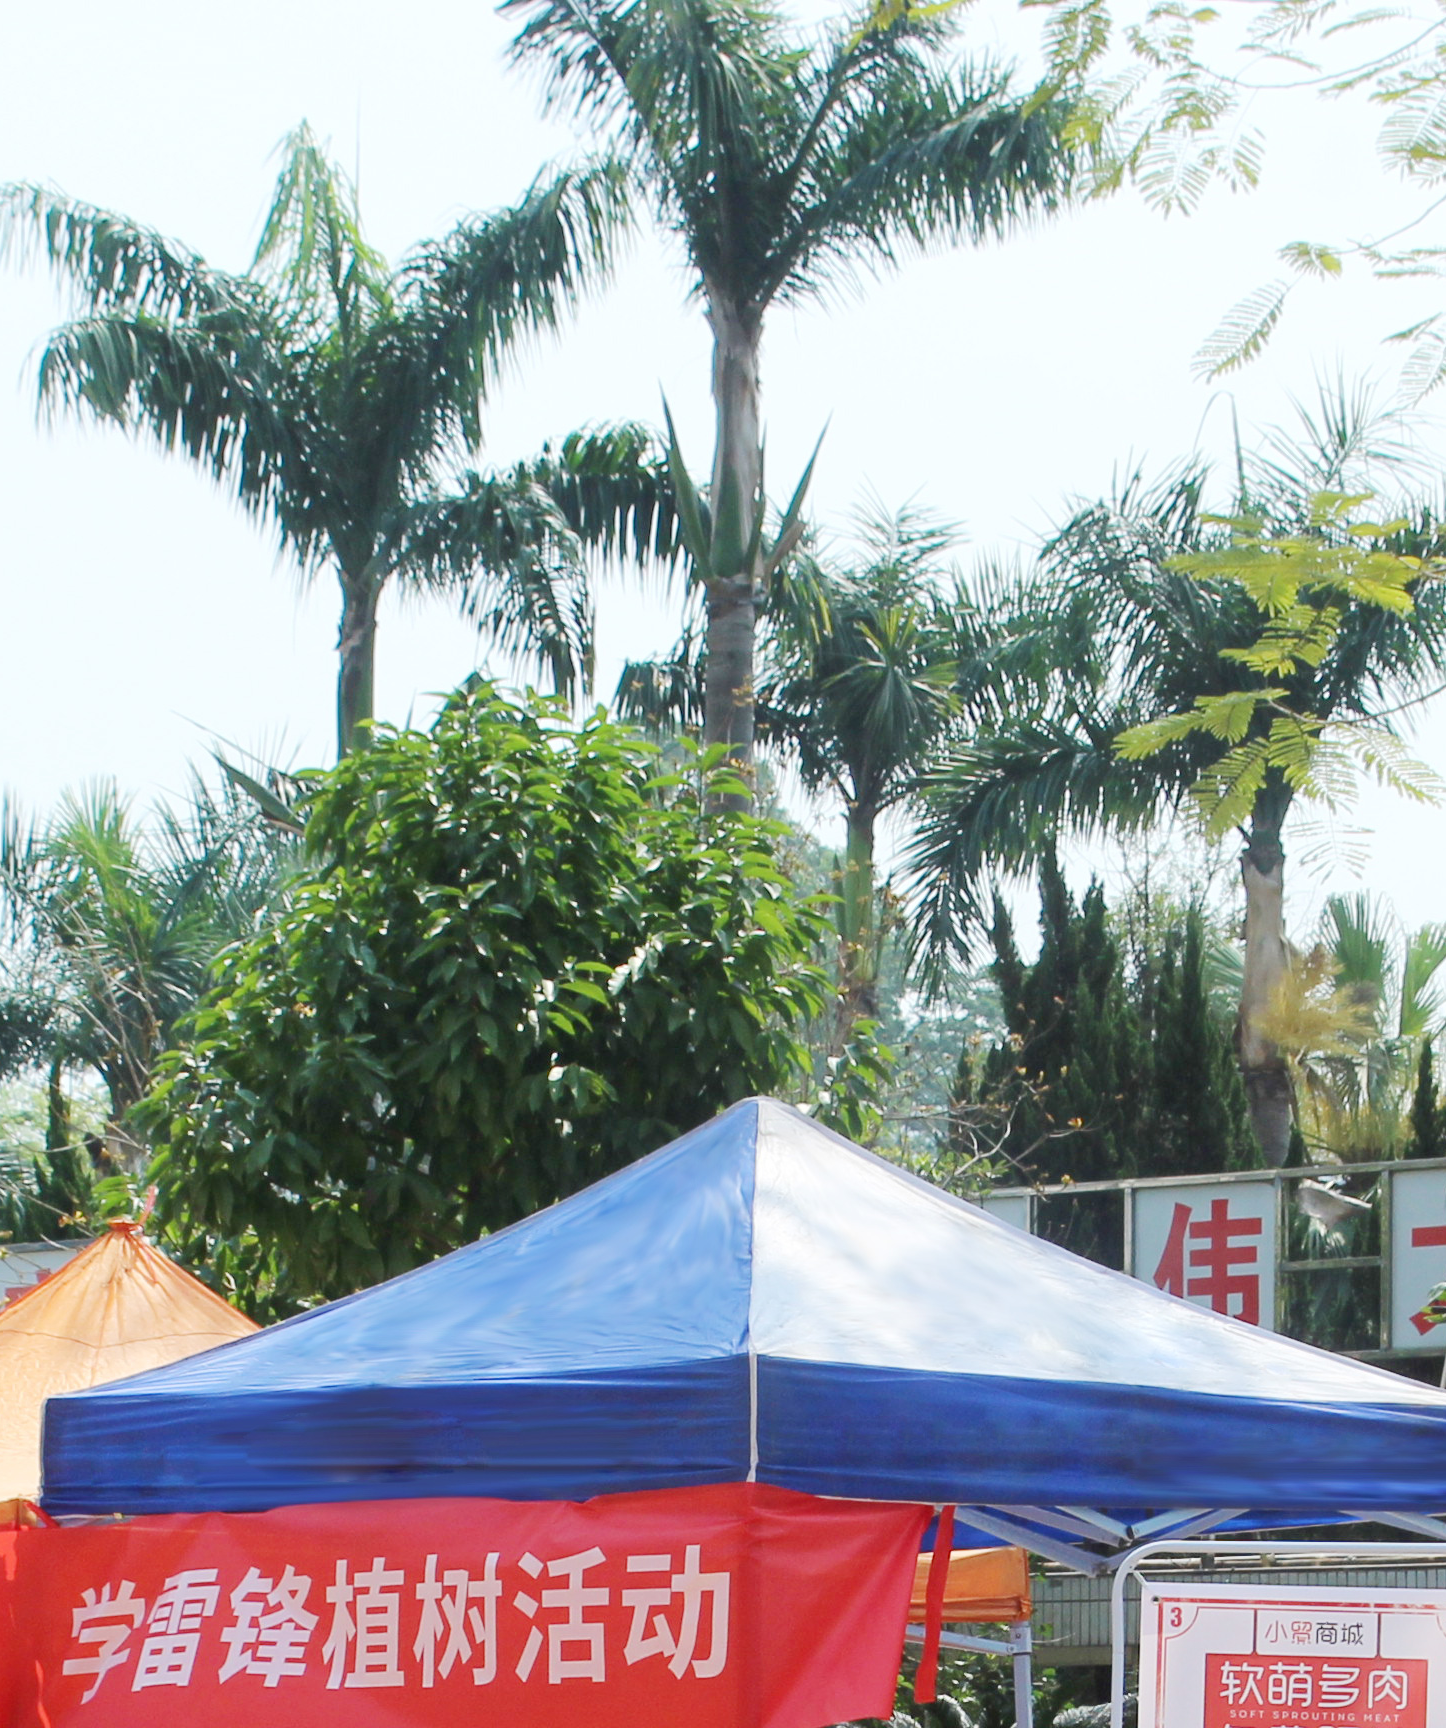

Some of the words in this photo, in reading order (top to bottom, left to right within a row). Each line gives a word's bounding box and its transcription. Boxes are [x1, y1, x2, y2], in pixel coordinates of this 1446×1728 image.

[62, 1543, 733, 1705] 学雷锋植树活动
[1169, 1606, 1184, 1628] 3
[1219, 1660, 1410, 1711] 软萌多肉
[1229, 1709, 1265, 1720] SOFT
[1272, 1711, 1356, 1722] SPROUTING
[1363, 1713, 1401, 1724] MEAT
